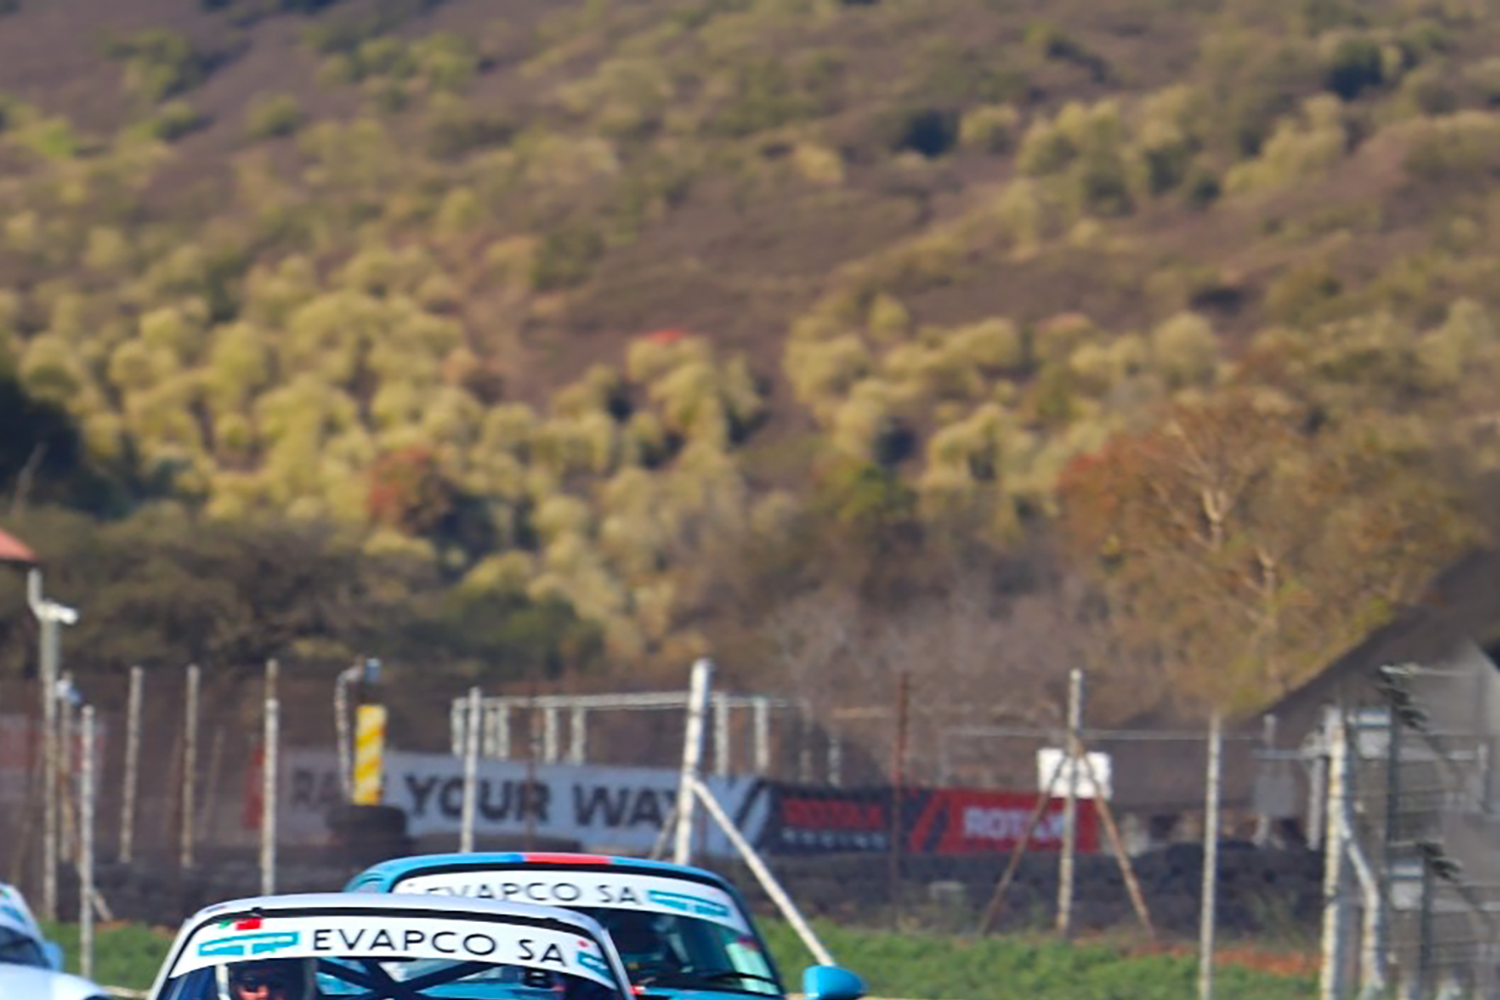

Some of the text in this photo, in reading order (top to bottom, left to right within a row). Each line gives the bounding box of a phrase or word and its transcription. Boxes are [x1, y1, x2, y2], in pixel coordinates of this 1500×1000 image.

[403, 774, 550, 825] YOUR
[598, 885, 641, 905] SA
[313, 928, 496, 956] EVAPCO
[519, 939, 567, 966] SA
